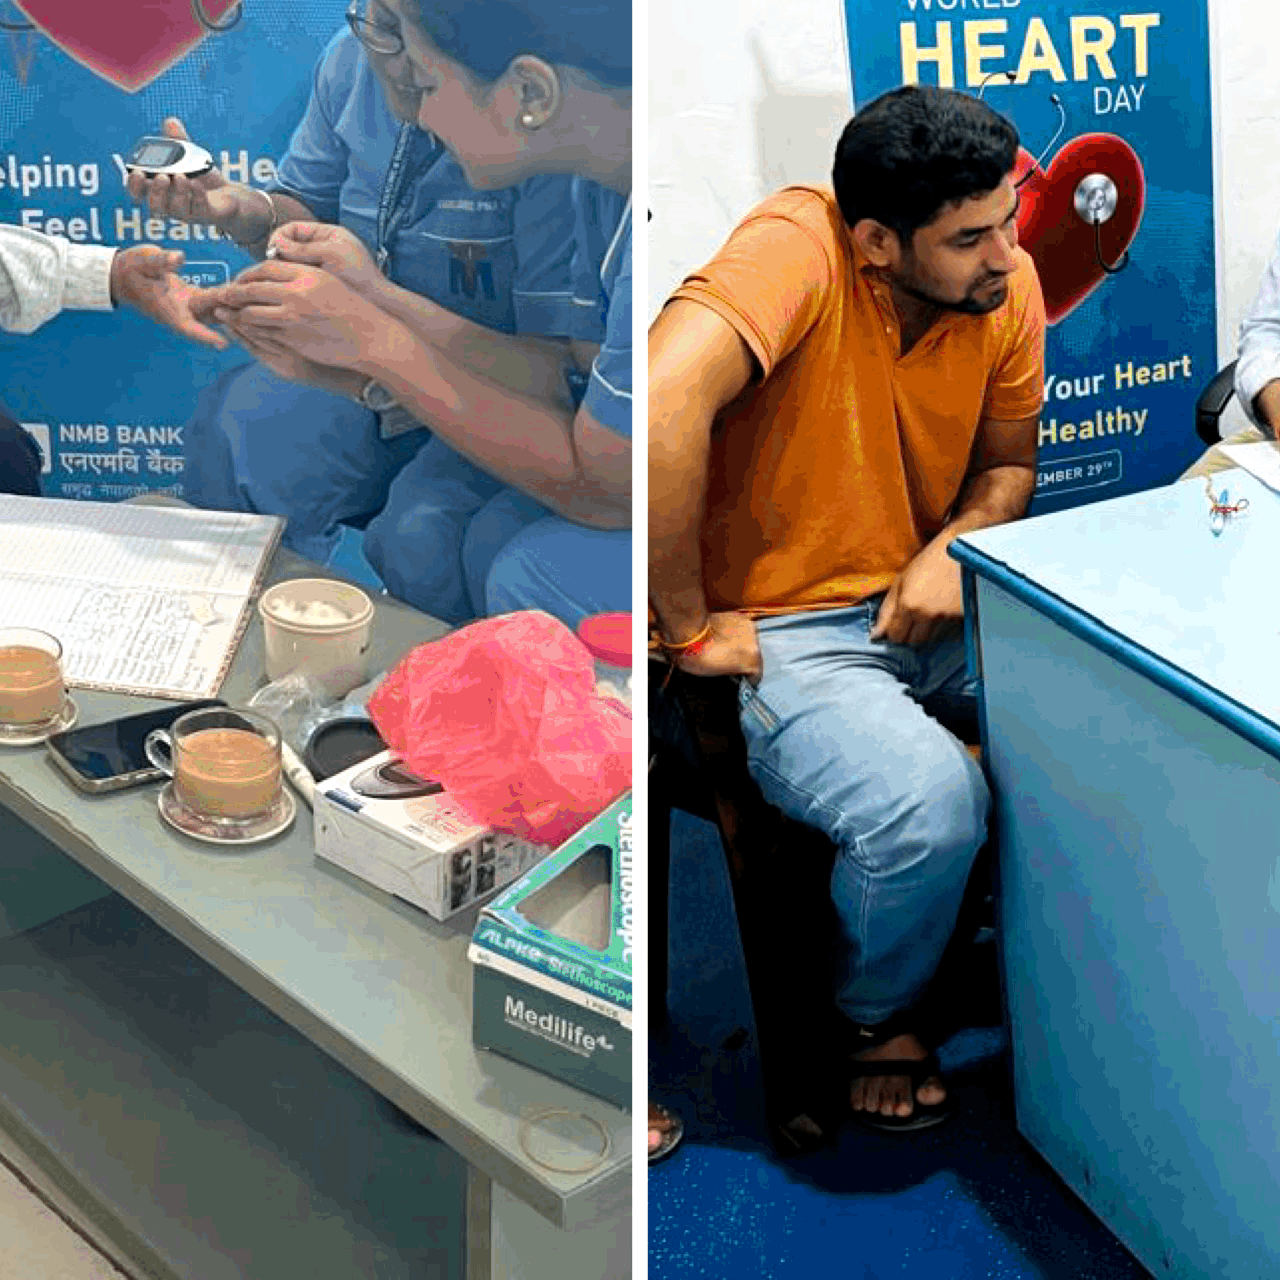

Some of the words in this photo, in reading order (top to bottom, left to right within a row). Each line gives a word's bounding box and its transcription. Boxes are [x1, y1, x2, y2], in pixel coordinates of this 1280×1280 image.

[899, 12, 1161, 89] HEART
[1093, 83, 1146, 115] DAY
[20, 206, 103, 240] Feel
[1114, 354, 1193, 390] Heart
[60, 423, 109, 444] NMB
[116, 424, 185, 446] BANK
[1037, 405, 1149, 448] Healthy
[1036, 466, 1083, 487] EMBER
[504, 994, 596, 1051] Medilife
